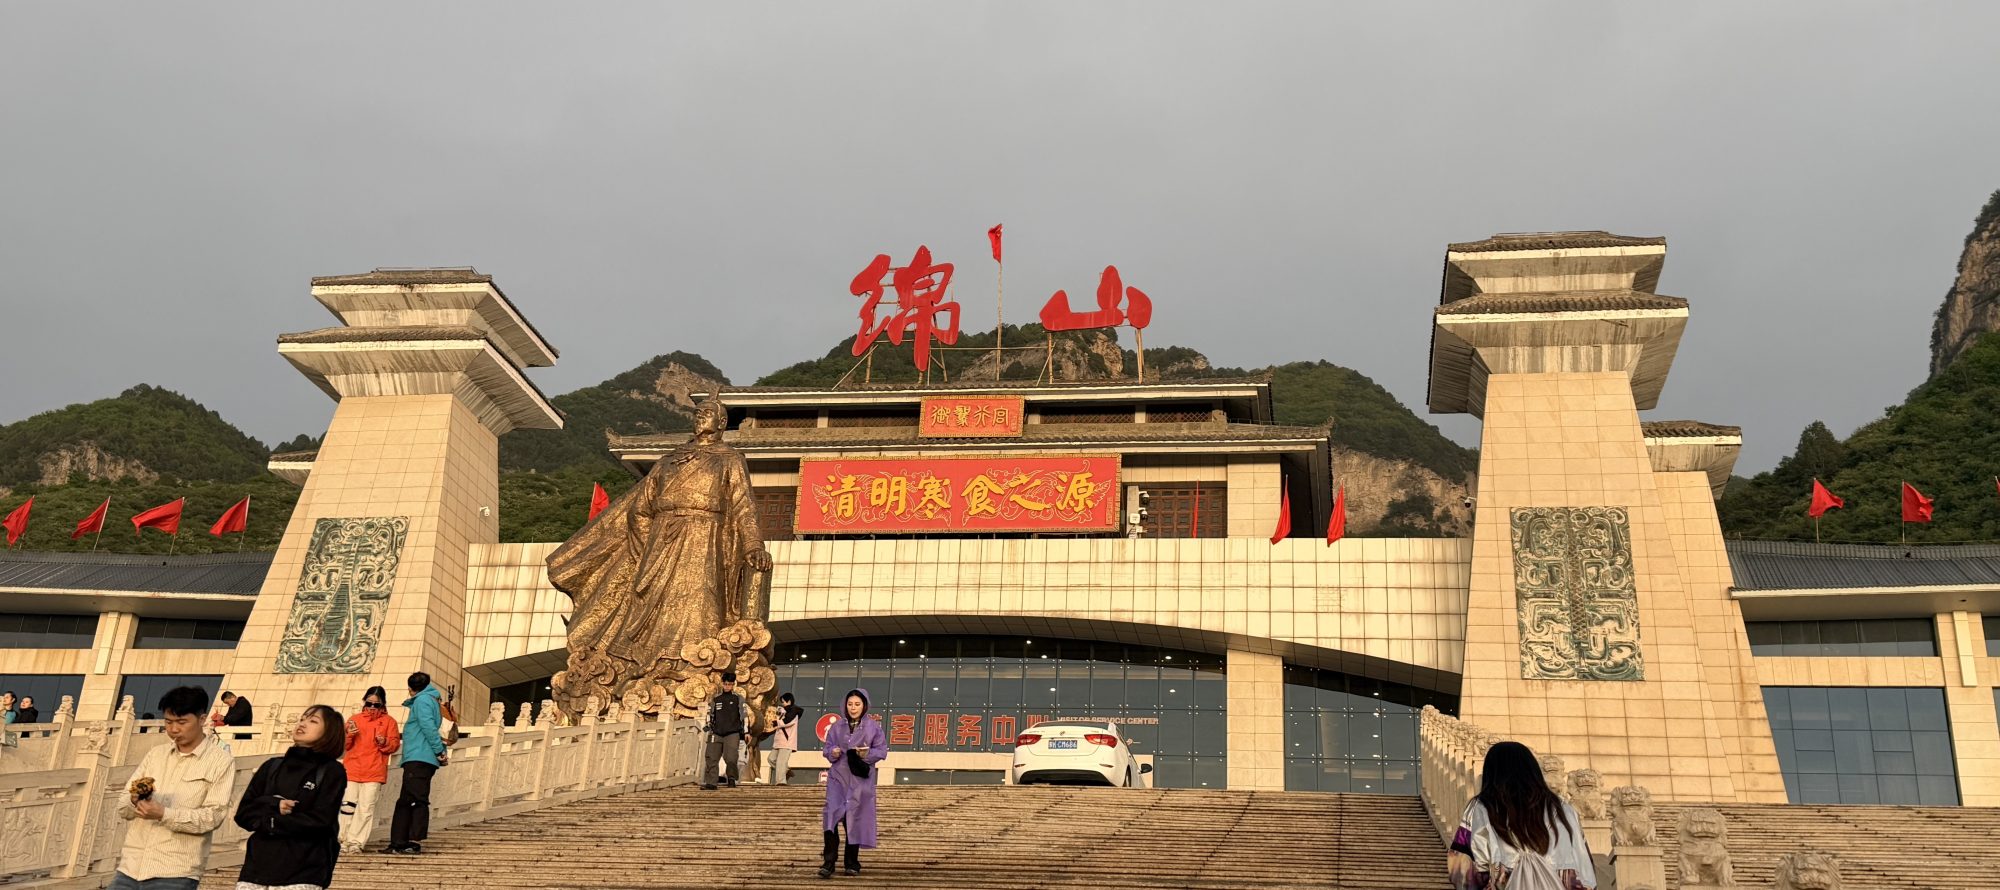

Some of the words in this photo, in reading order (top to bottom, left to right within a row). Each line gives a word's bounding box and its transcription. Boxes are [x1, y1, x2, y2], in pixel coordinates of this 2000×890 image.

[820, 472, 1096, 518] 清明寒食之源
[868, 713, 1048, 746] 客服务中
[1127, 717, 1159, 725] CENTER
